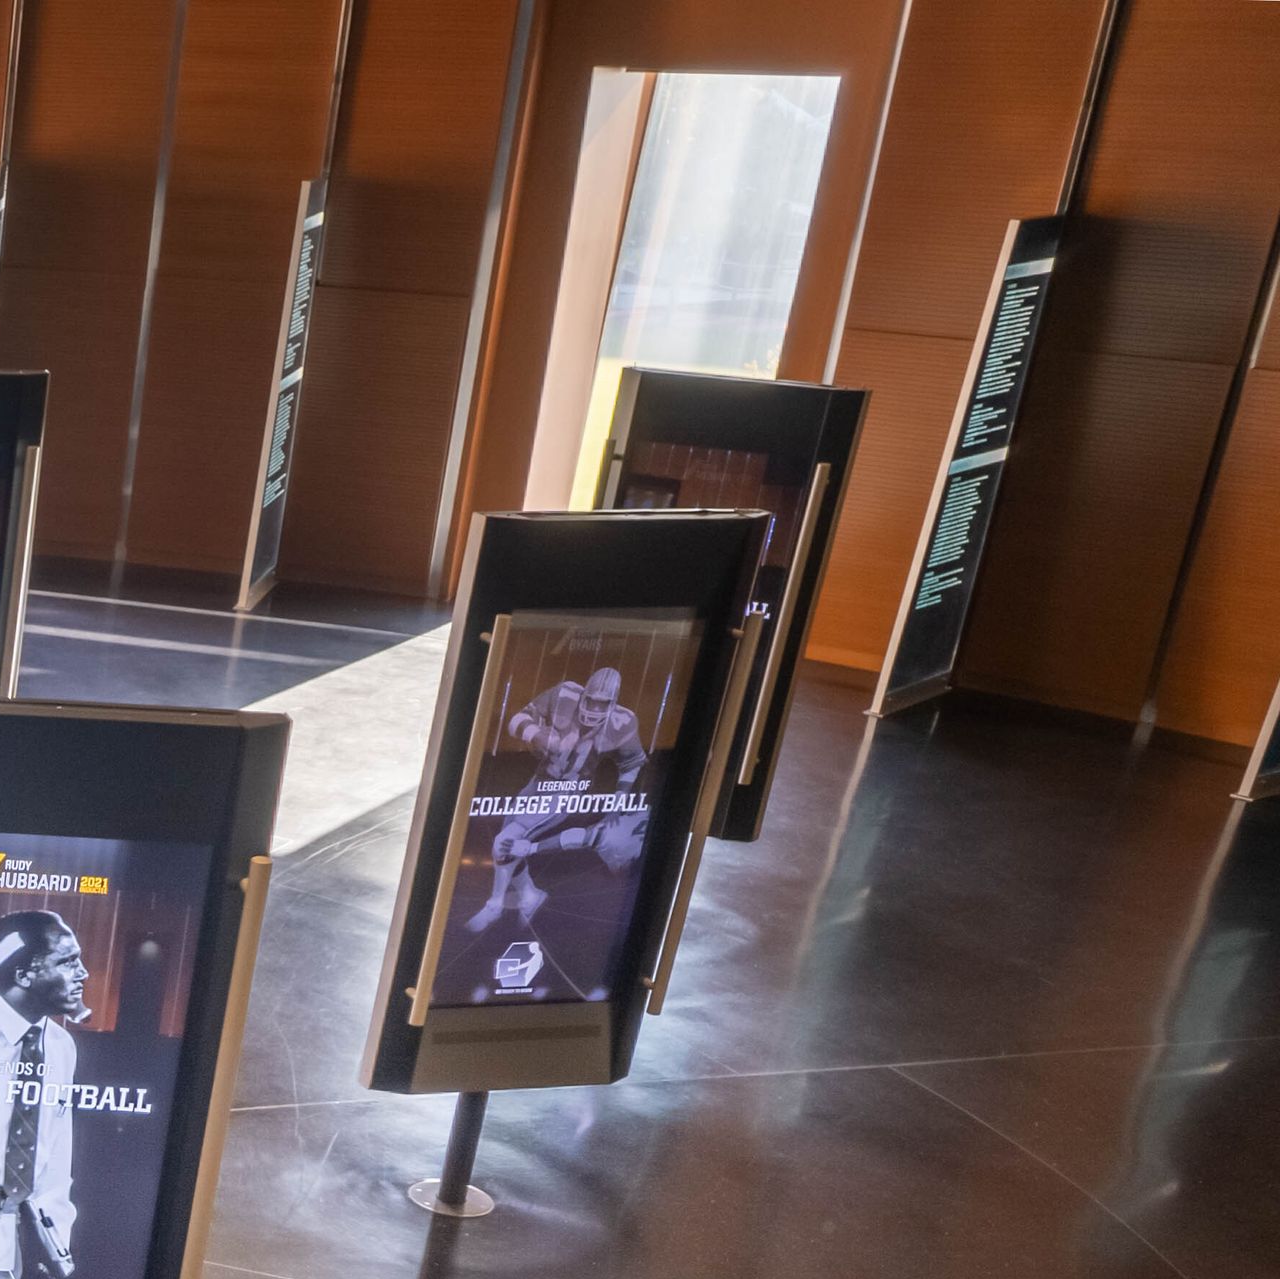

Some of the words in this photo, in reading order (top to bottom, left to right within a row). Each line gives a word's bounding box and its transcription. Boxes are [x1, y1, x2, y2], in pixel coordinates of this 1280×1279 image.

[537, 781, 577, 791] LEGENDS
[578, 780, 591, 791] OF
[469, 795, 552, 816] COLLEGE
[555, 793, 648, 814] FOOTBALL
[5, 859, 32, 871] RUDY
[81, 876, 108, 888] 2021
[36, 1063, 54, 1076] OF
[5, 1080, 152, 1114] FOOTBALL
